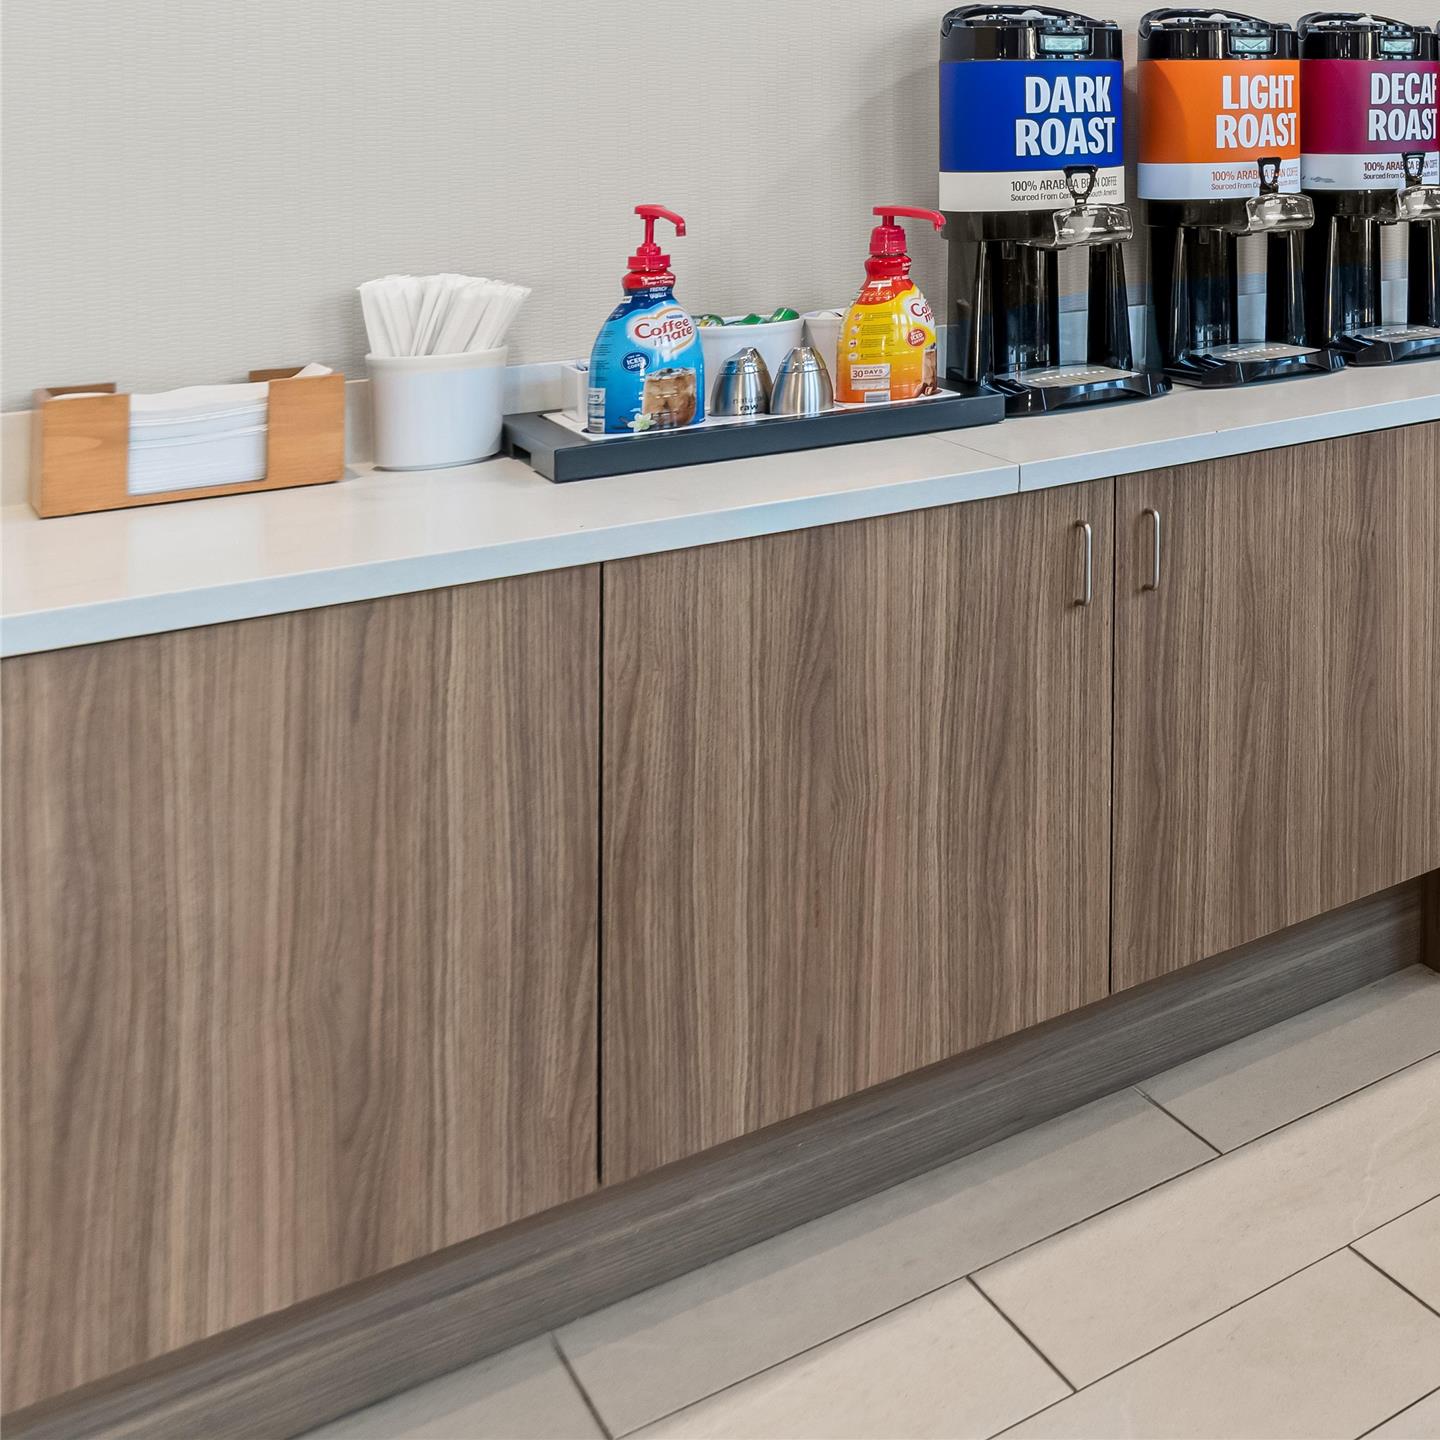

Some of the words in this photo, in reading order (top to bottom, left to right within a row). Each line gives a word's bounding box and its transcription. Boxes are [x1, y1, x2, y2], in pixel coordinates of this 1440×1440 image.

[1025, 76, 1111, 113] DARK
[1222, 75, 1294, 109] LIGHT
[1371, 72, 1437, 105] DECAF
[1015, 116, 1116, 157] ROAST
[1216, 112, 1296, 149] ROAST
[1368, 108, 1437, 141] ROAST
[1212, 171, 1235, 181] 100%
[1363, 162, 1384, 172] 100%
[1011, 180, 1037, 192] 100%
[1011, 193, 1040, 202] Sourced
[1040, 192, 1058, 201] From
[634, 318, 689, 339] Coffee
[852, 370, 864, 378] 30
